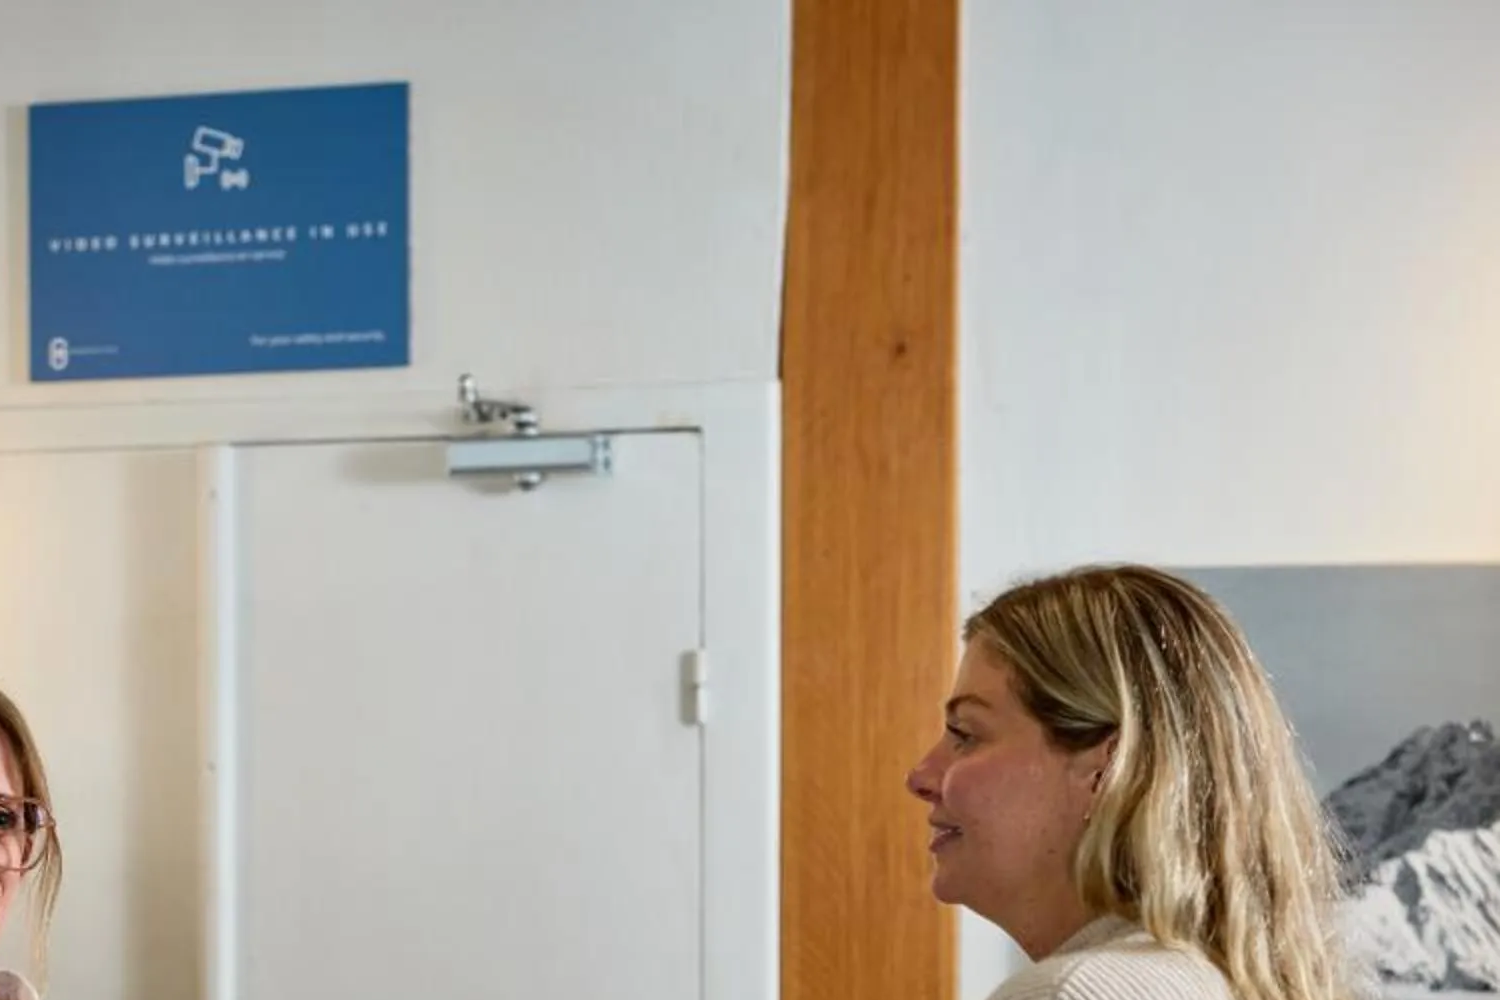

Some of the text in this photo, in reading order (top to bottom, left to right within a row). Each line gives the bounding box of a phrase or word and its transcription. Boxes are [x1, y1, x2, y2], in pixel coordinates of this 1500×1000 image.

[48, 222, 389, 253] VIDEO SURVEILLANCE IN USE
